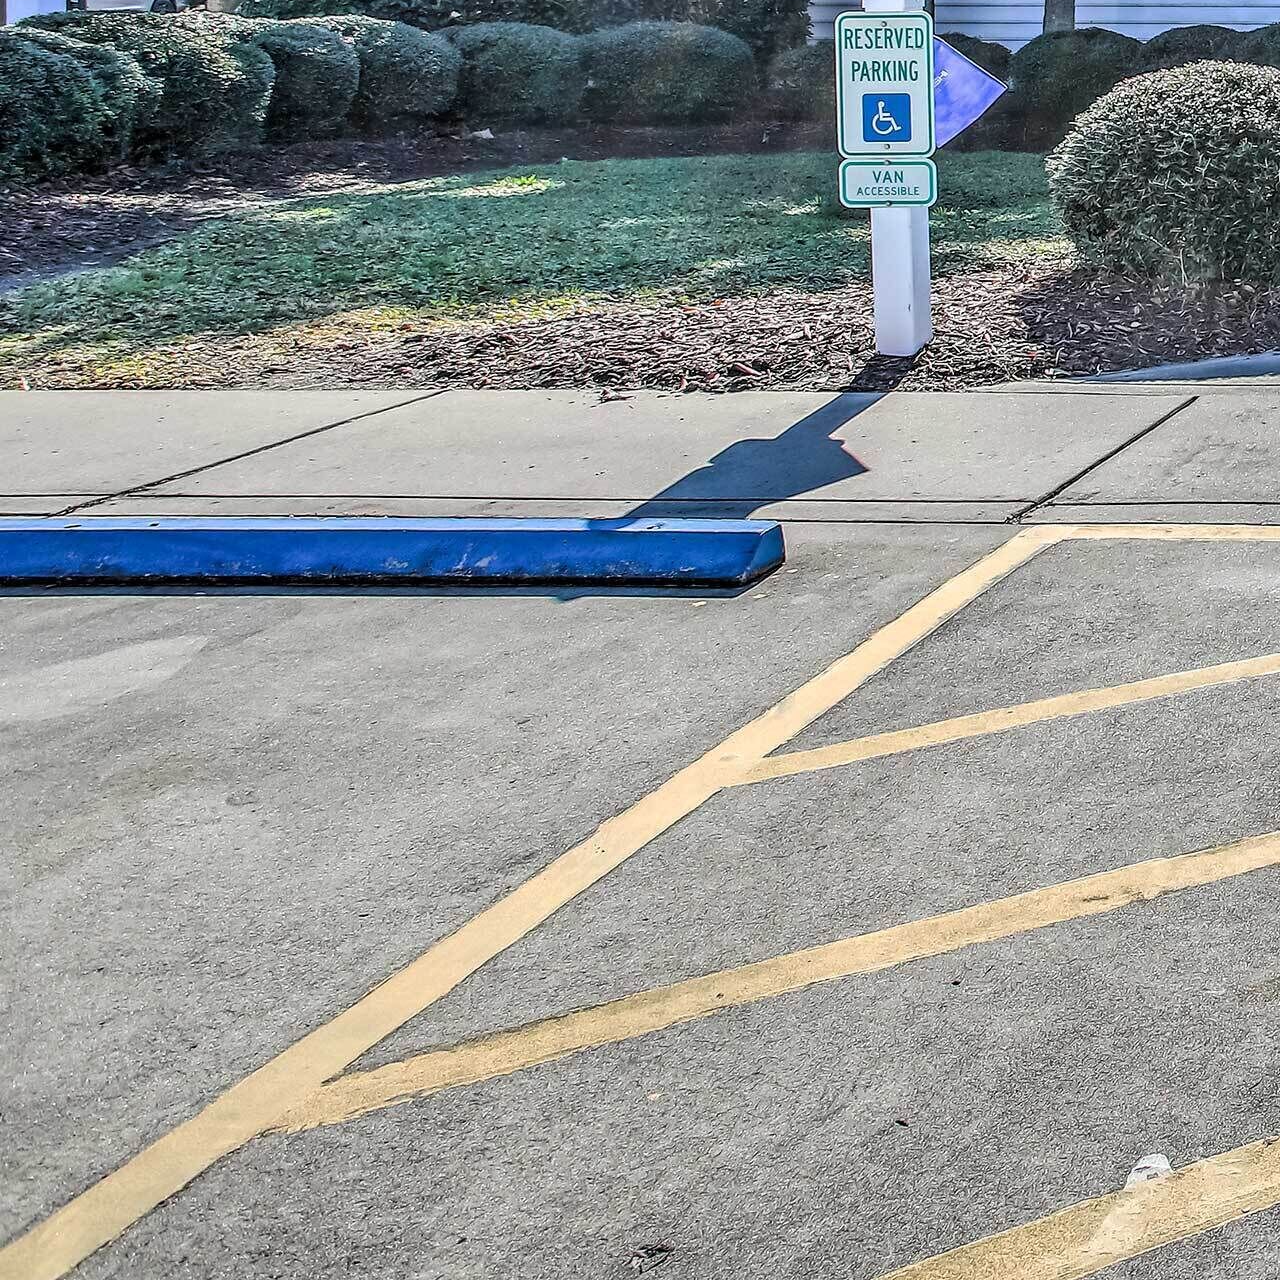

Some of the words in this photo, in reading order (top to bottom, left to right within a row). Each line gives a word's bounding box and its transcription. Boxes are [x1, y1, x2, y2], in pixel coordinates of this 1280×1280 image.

[844, 28, 924, 50] RESERVED
[851, 60, 919, 82] PARKING
[872, 170, 904, 184] VAN
[856, 186, 920, 196] ACCESSIBLE
